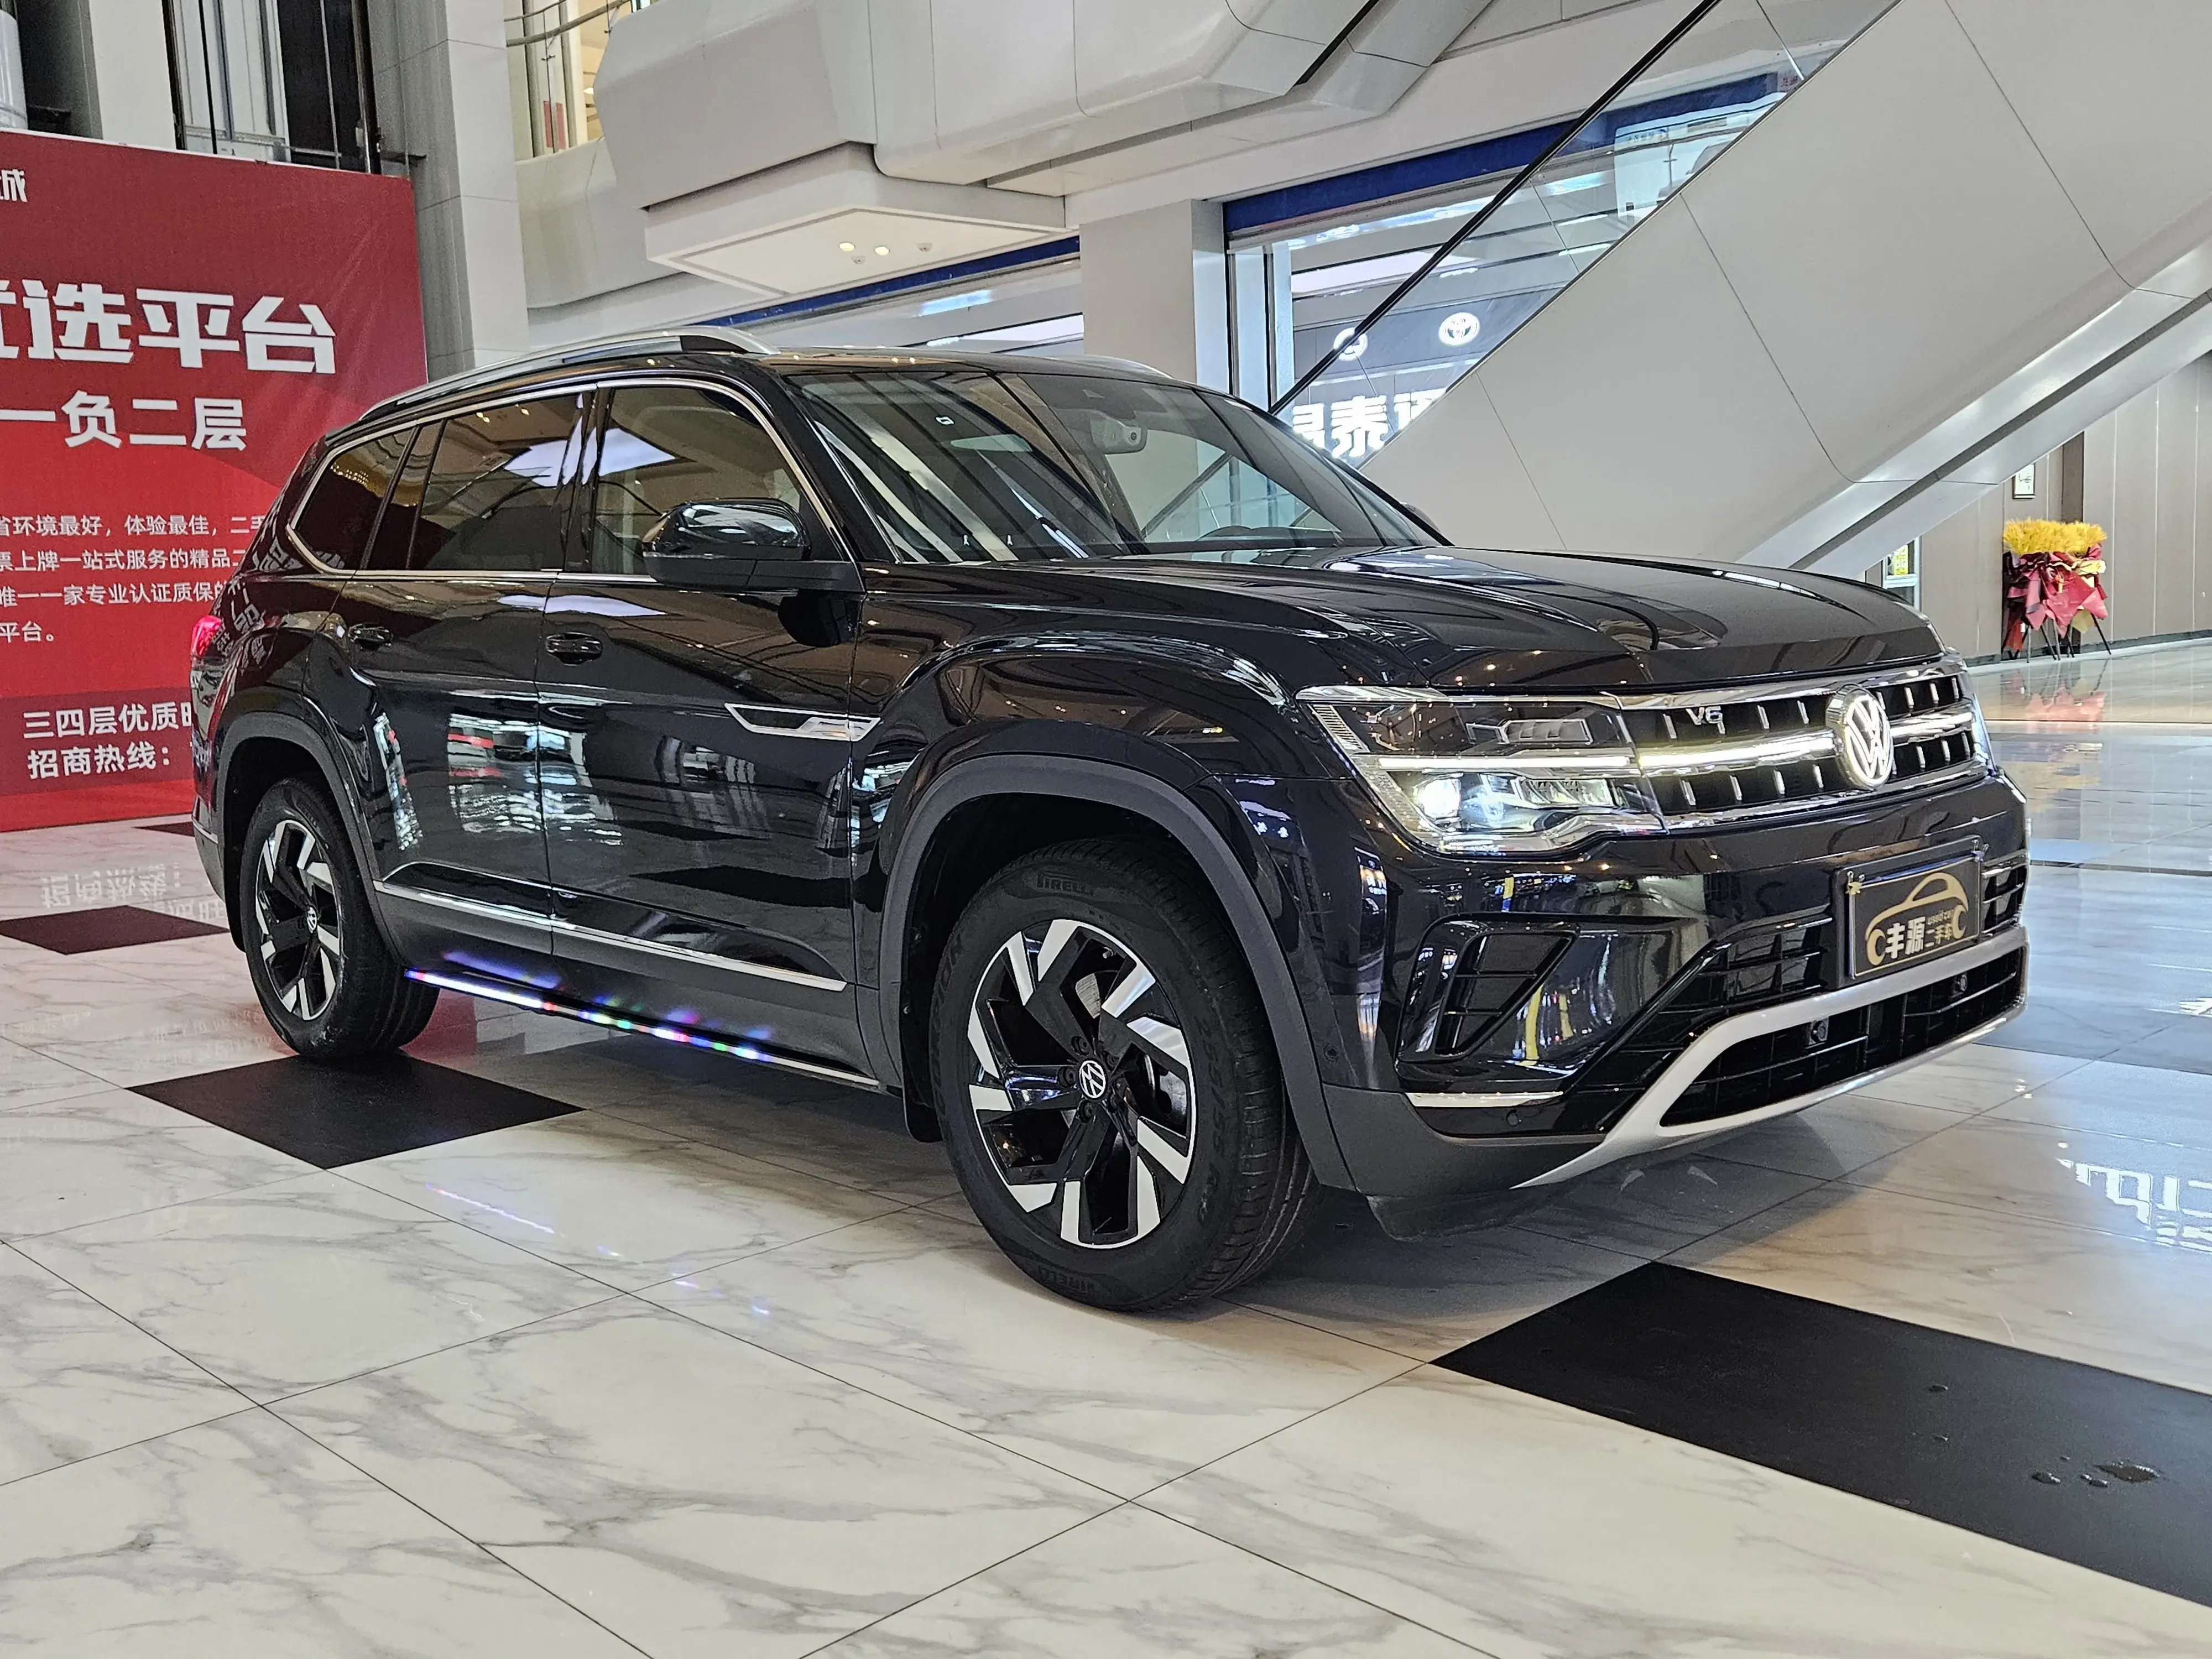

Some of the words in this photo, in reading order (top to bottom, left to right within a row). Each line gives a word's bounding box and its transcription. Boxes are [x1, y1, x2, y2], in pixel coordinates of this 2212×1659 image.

[1685, 706, 1724, 726] V6
[28, 740, 170, 780] 招商热线：
[1885, 916, 1926, 959] 丰源
